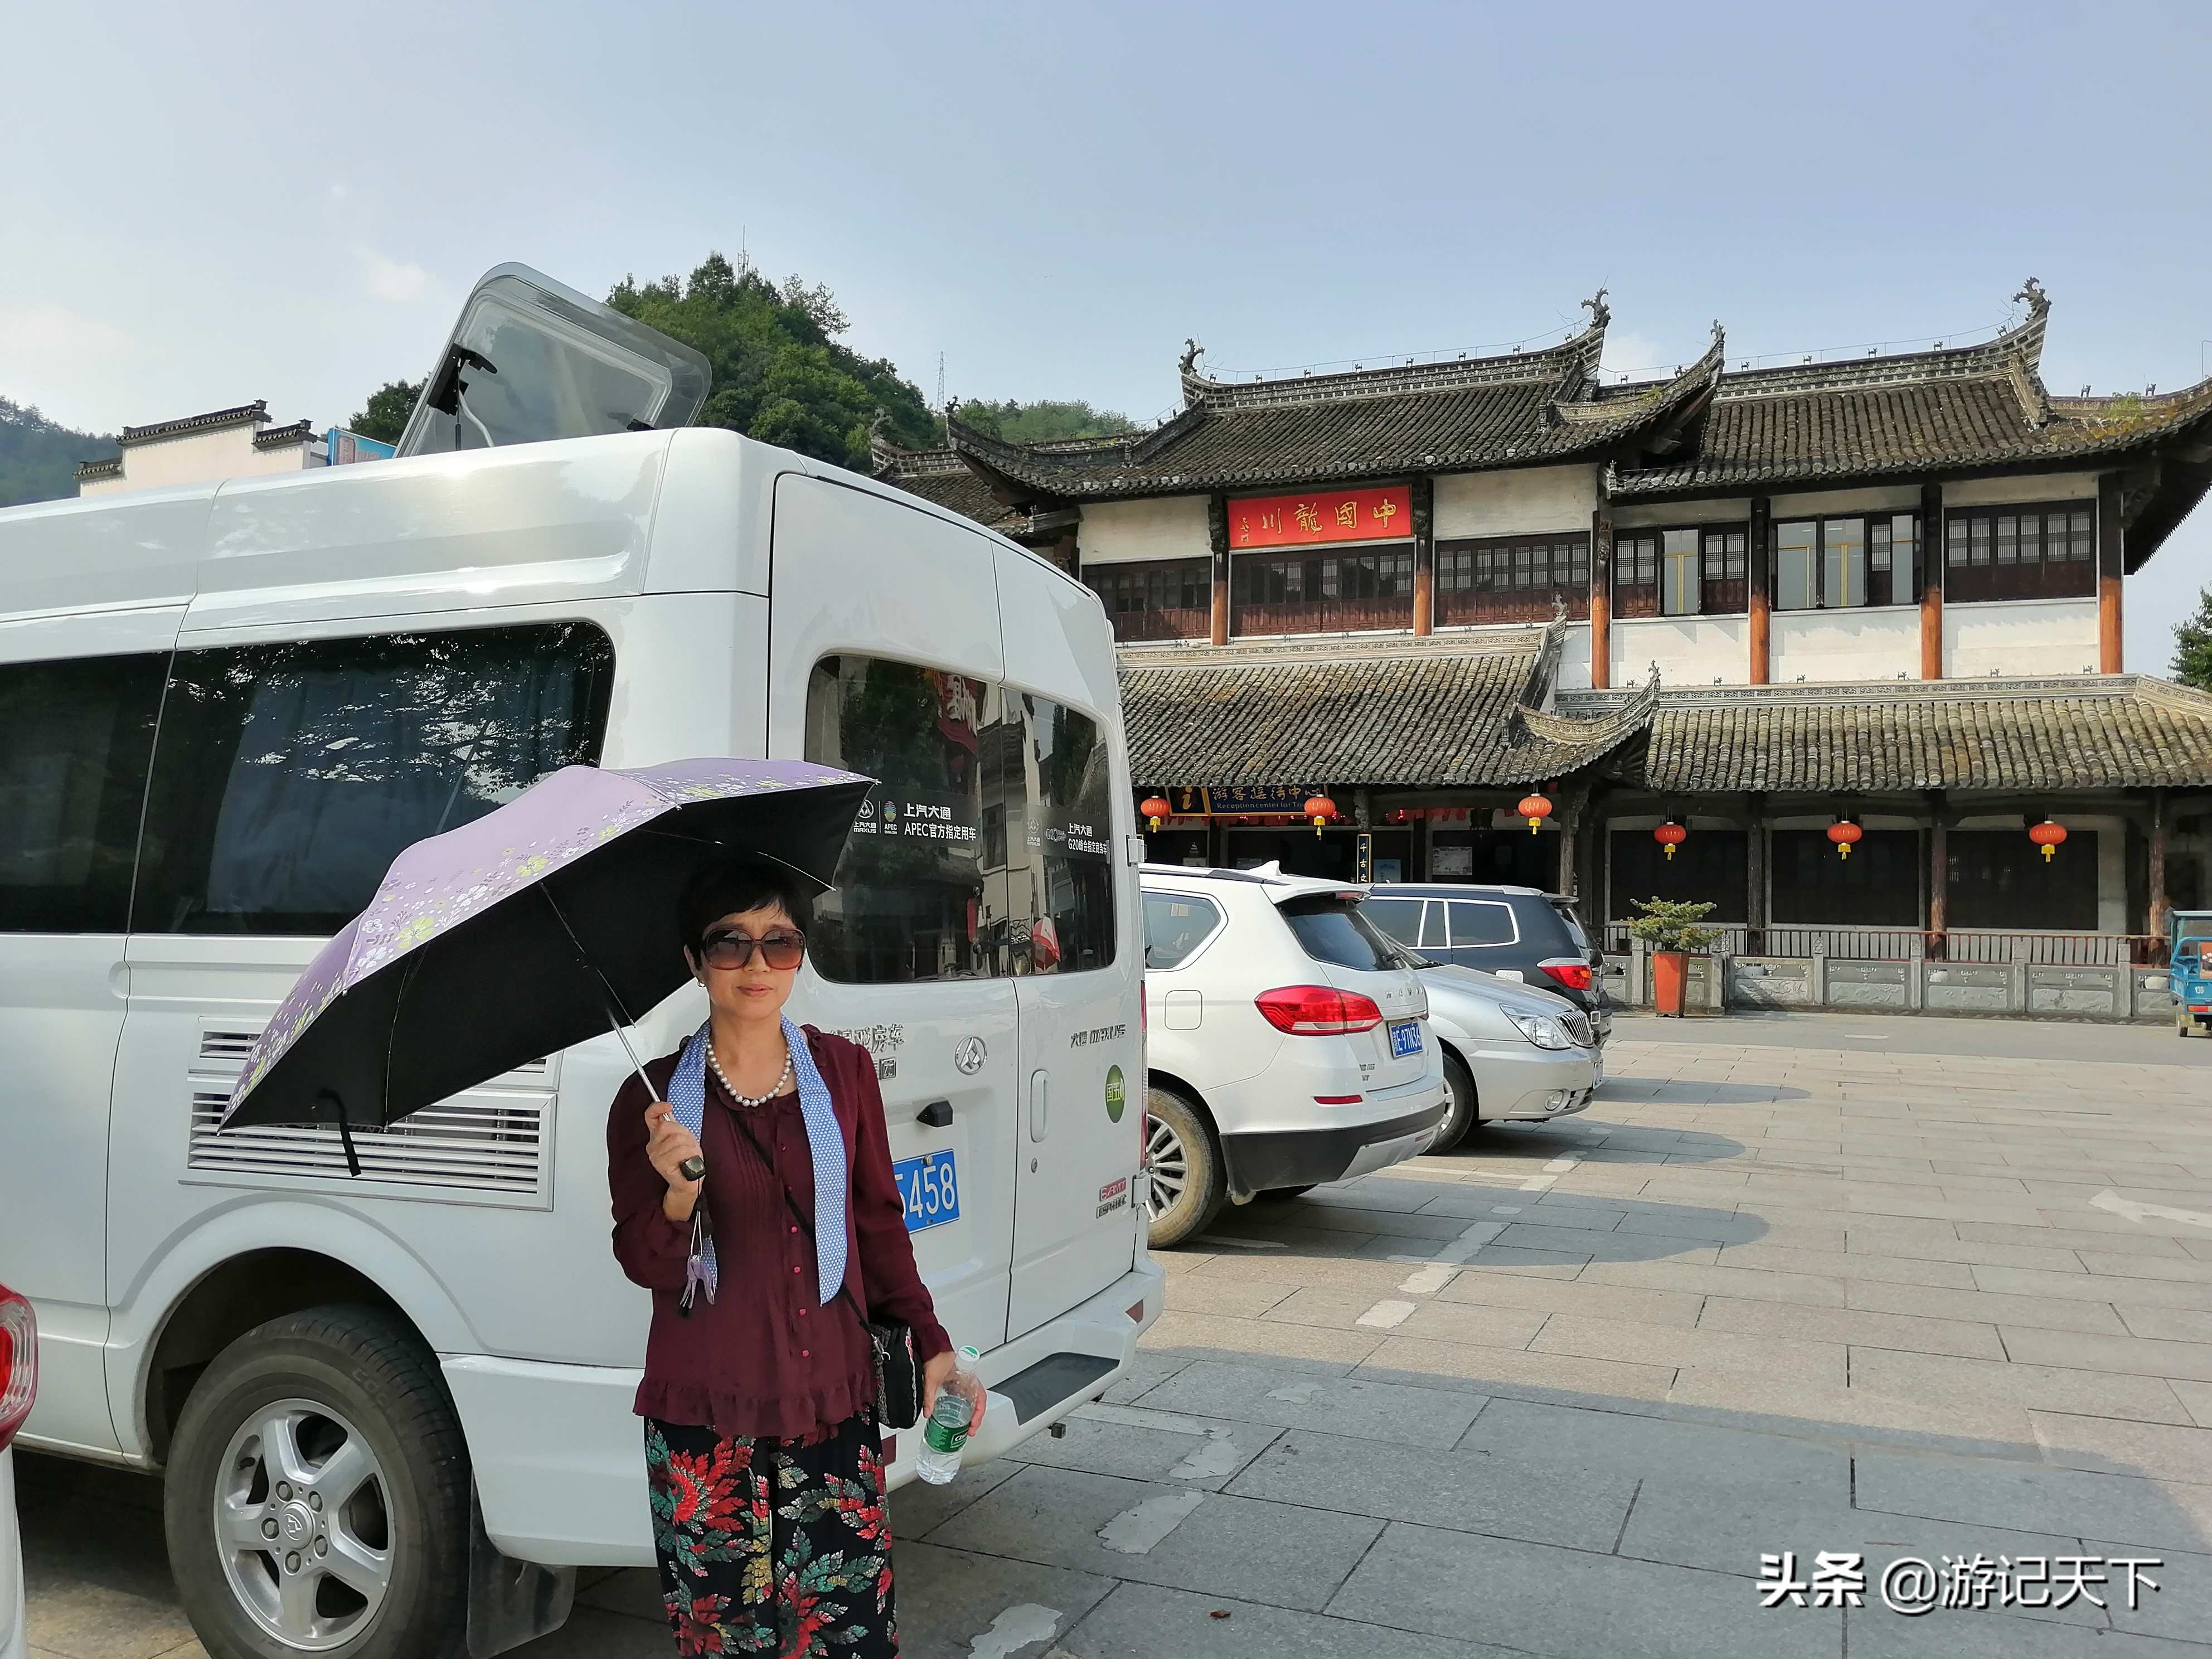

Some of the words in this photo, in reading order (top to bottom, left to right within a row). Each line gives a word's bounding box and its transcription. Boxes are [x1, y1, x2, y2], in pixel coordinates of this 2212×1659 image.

[904, 803, 952, 820] 上汽大通
[1068, 822, 1093, 837] 上汽大通
